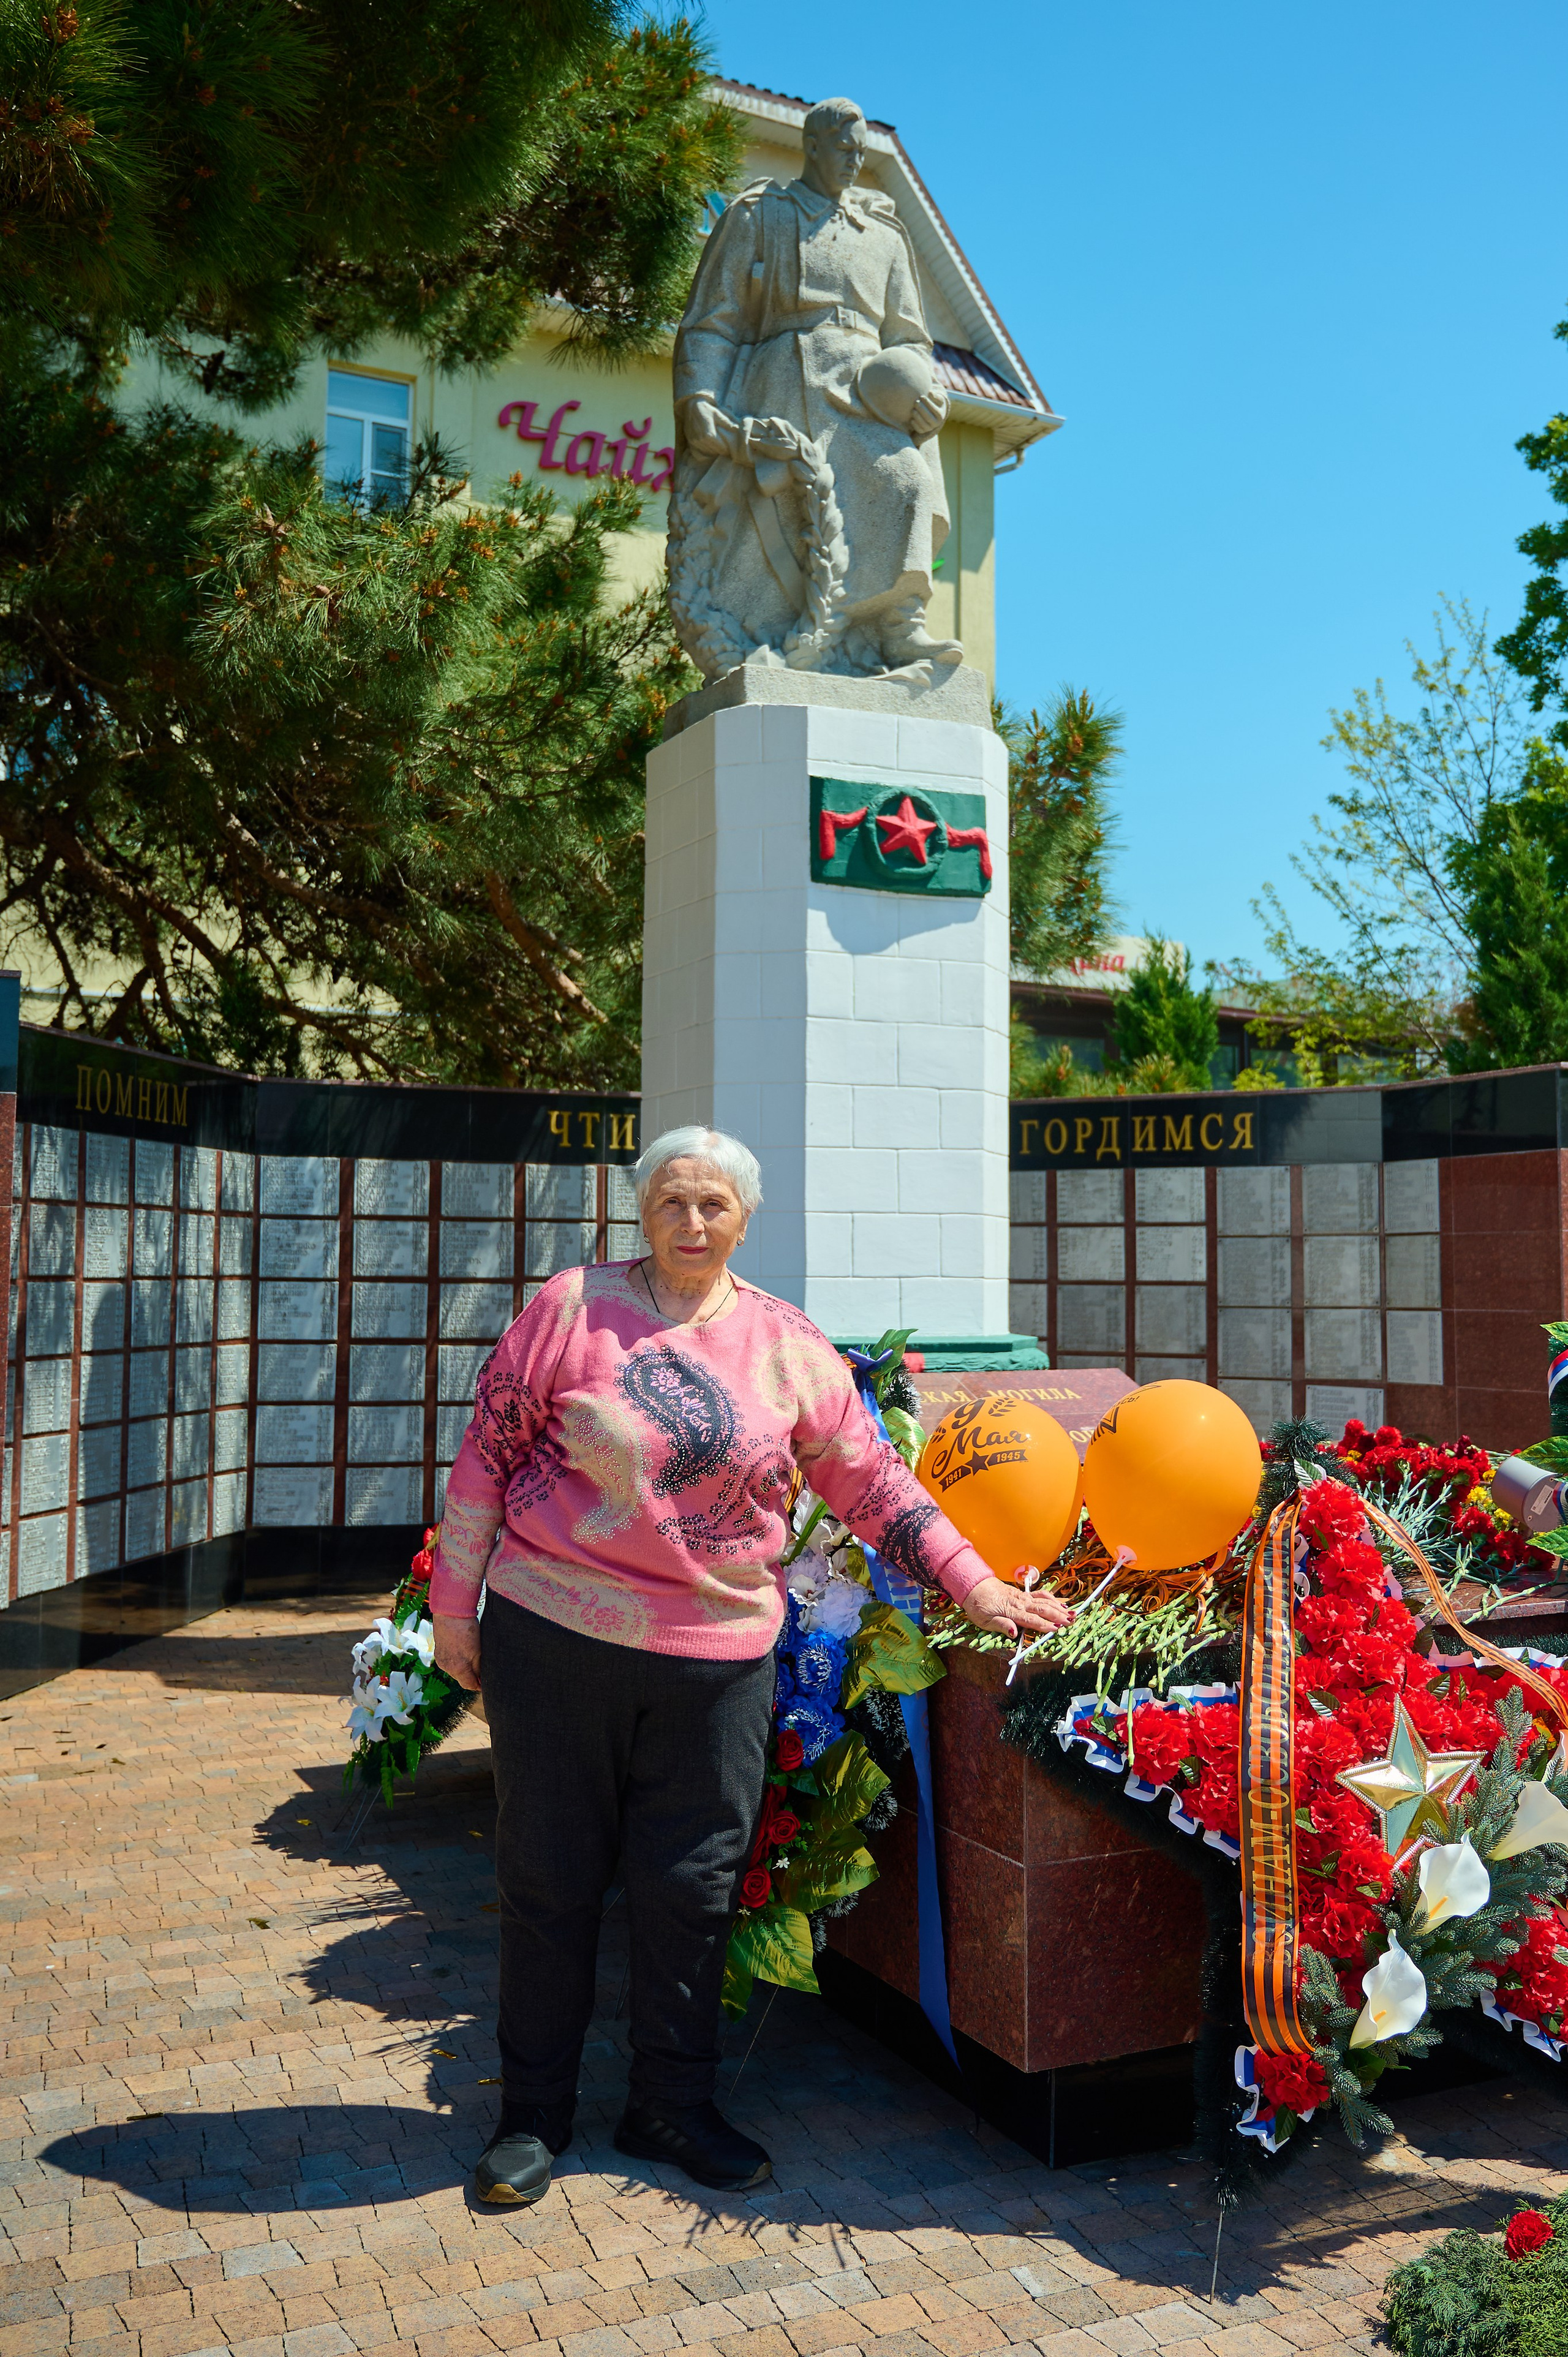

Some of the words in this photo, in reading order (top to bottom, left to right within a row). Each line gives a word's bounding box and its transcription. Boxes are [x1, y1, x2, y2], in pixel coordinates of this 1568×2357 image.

[75, 1065, 188, 1126] ПОМНИМ
[1019, 1112, 1254, 1161] ГОРДИМСЯ
[951, 1398, 986, 1429] 9
[931, 1427, 1029, 1479] Мая
[945, 1469, 962, 1487] 1941
[996, 1450, 1020, 1463] 1945
